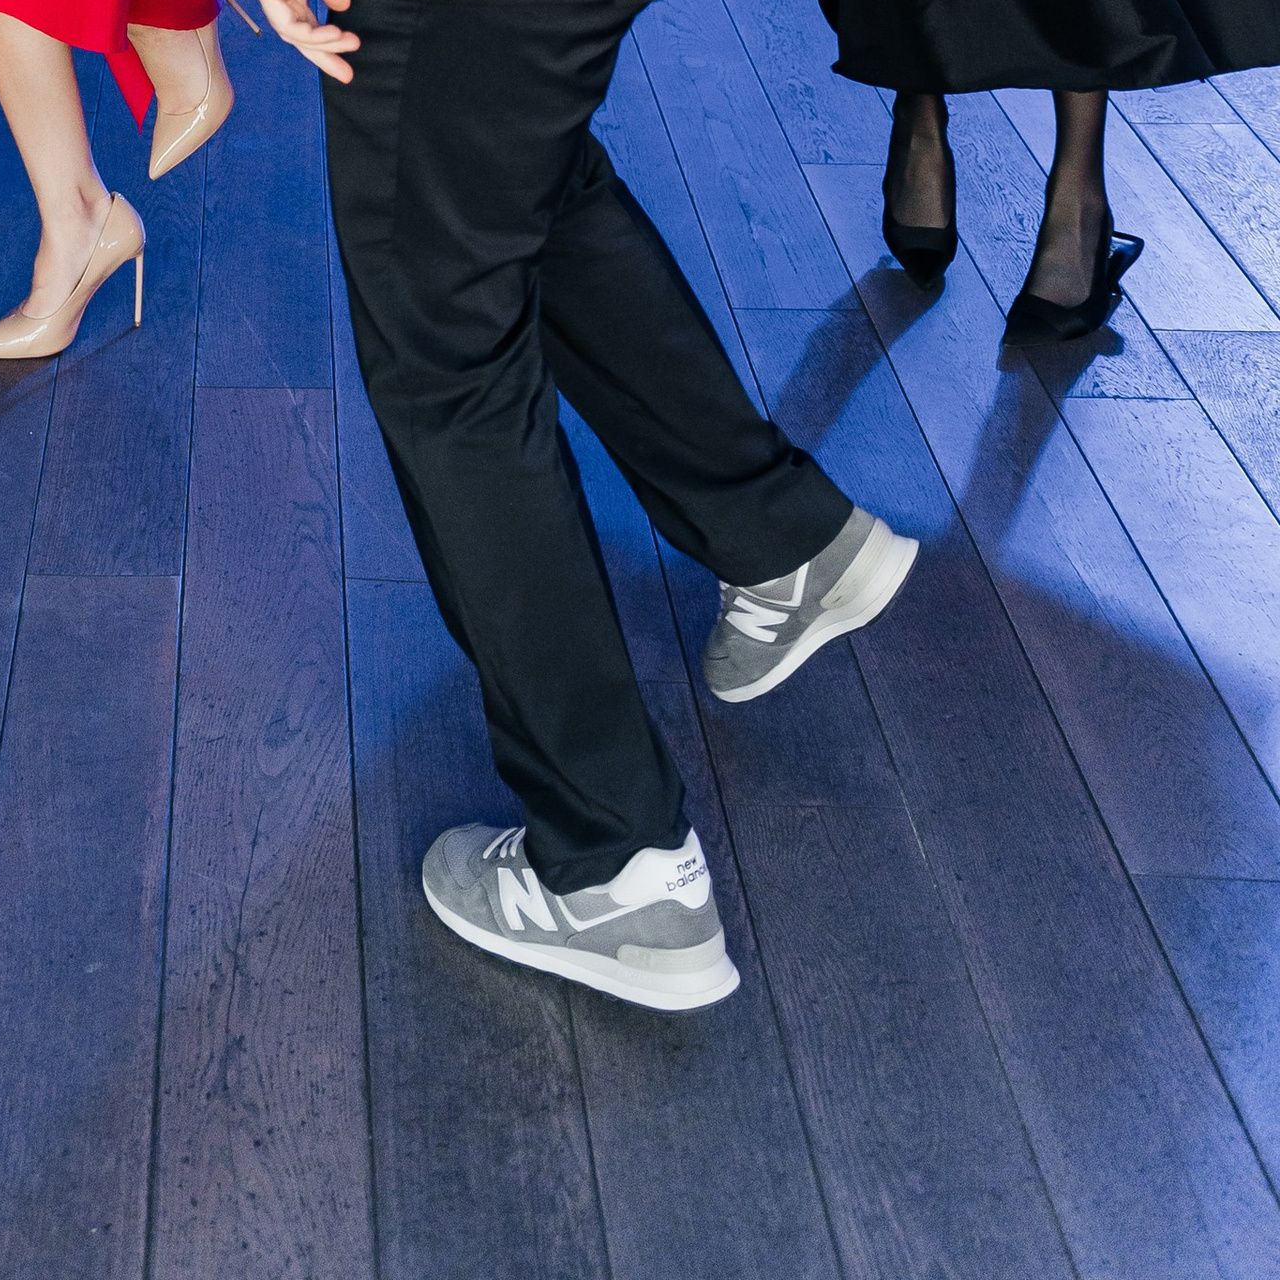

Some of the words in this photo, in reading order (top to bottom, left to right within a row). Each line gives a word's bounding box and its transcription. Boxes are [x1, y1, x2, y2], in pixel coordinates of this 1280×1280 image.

[725, 595, 790, 643] N
[676, 856, 697, 874] new
[497, 867, 558, 931] N
